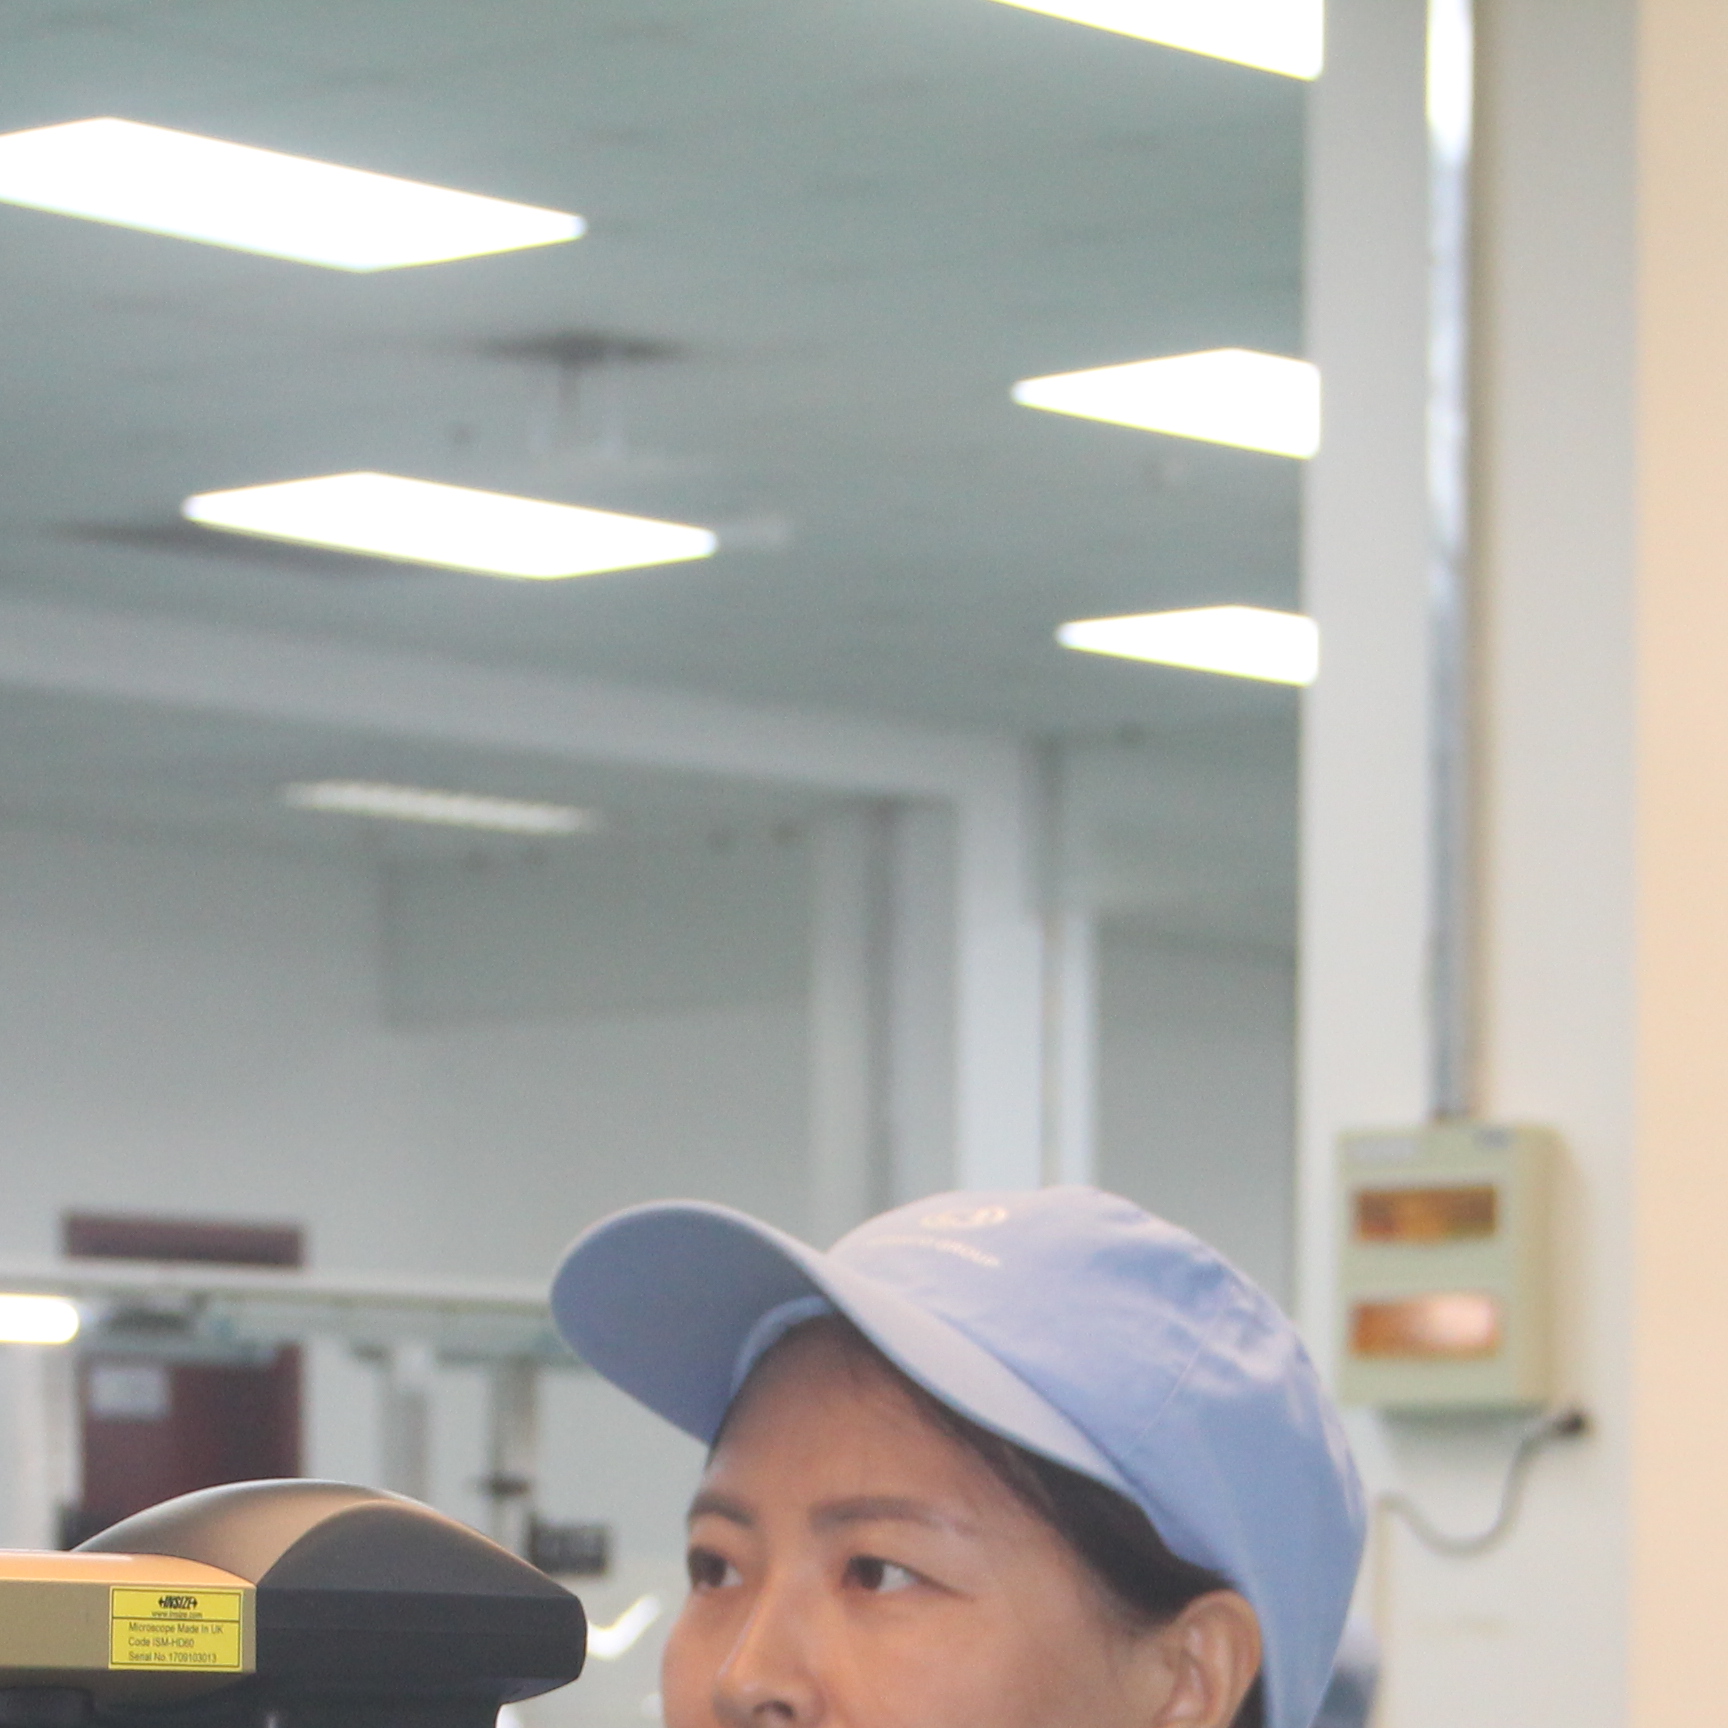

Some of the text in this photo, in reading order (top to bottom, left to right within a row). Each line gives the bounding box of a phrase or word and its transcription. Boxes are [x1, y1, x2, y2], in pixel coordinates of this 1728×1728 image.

[129, 1622, 175, 1635] Microscope
[177, 1623, 199, 1634] Made
[211, 1625, 223, 1634] UK
[128, 1637, 150, 1647] Code
[129, 1651, 152, 1661] Serial
